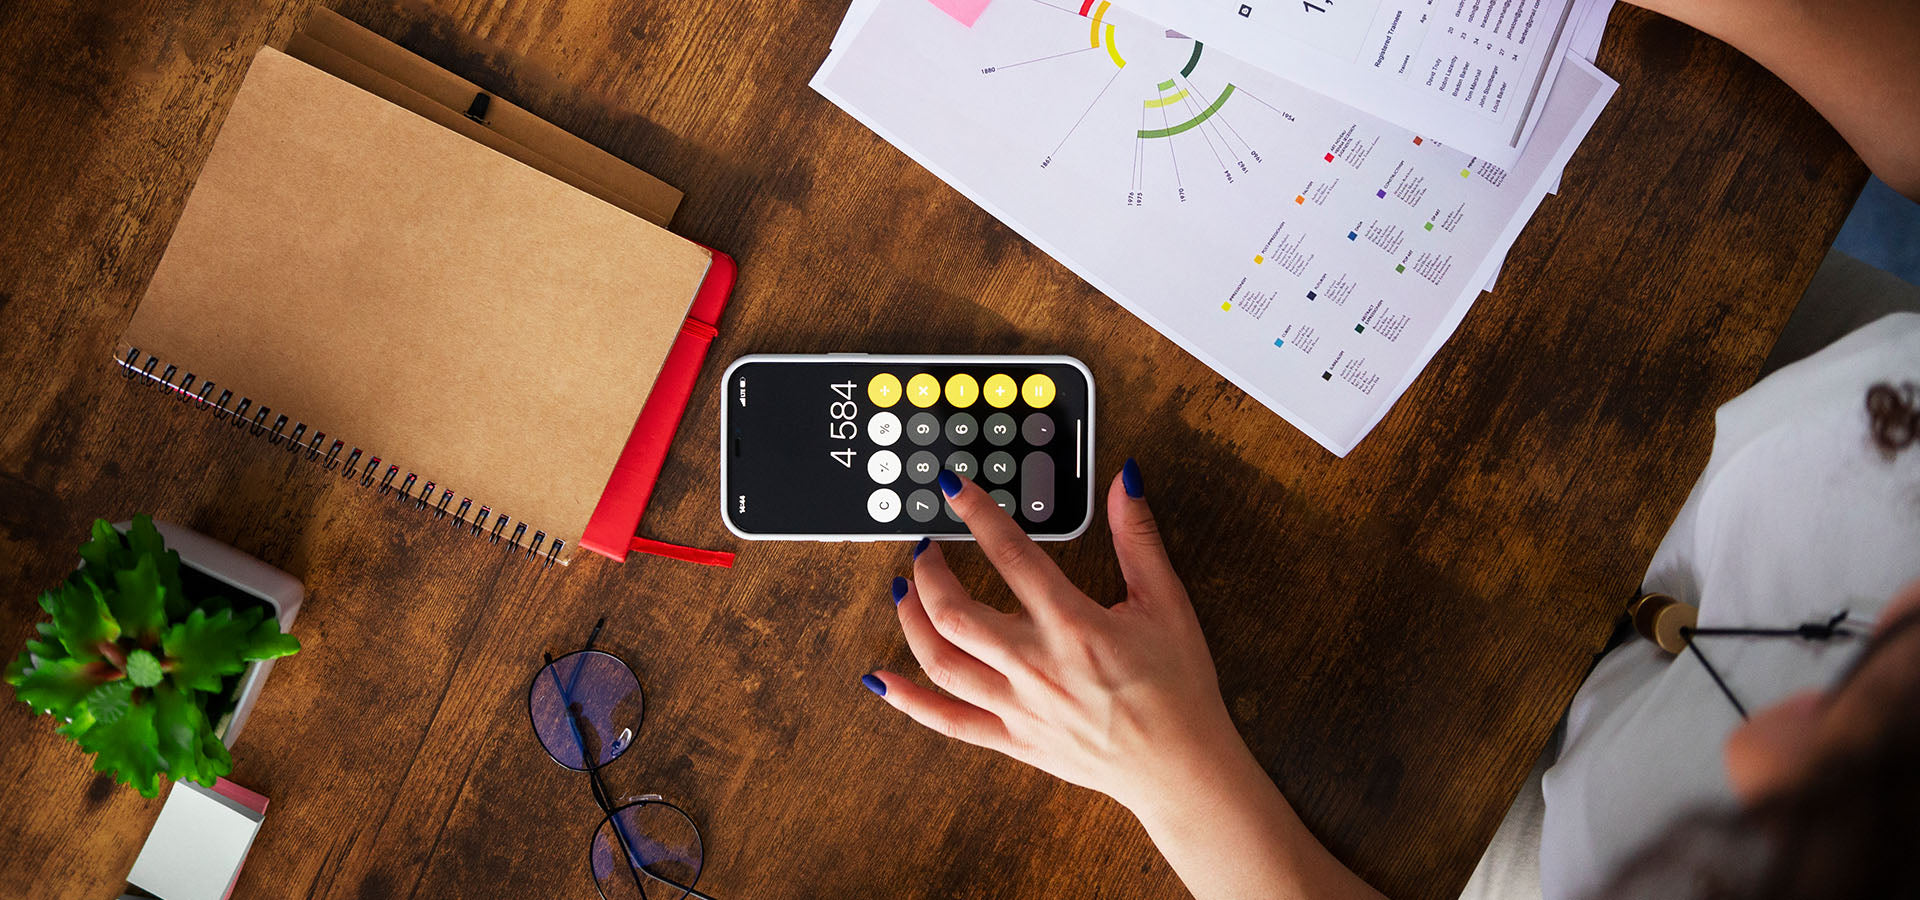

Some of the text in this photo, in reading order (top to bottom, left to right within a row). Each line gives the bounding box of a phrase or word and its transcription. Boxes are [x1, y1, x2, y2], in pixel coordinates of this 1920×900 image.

[1374, 10, 1402, 68] Registered Trainees
[1426, 71, 1436, 86] David
[1447, 26, 1454, 34] 20
[1439, 76, 1449, 92] Robin
[1460, 32, 1467, 40] 23
[1398, 55, 1410, 74] Trainees
[1452, 79, 1463, 97] Bradon
[1459, 61, 1470, 79] Barber
[1478, 95, 1487, 108] John
[1499, 48, 1505, 56] 27
[1464, 90, 1474, 102] Tom
[1470, 69, 1482, 90] Marshall
[1491, 99, 1501, 113] Louis
[1497, 82, 1507, 99] Barber
[1282, 112, 1295, 122] 1954
[1040, 156, 1052, 169] 1867
[1250, 150, 1262, 163] 1960
[1237, 159, 1249, 174] 1962
[1224, 170, 1234, 184] 1964
[1178, 188, 1186, 202] 1970
[830, 380, 858, 468] 4 584
[880, 423, 890, 435] %
[917, 424, 930, 434] 9
[955, 424, 968, 434] 6
[994, 425, 1007, 434] 3
[916, 463, 929, 472] 8
[955, 463, 968, 472] 5
[993, 463, 1006, 472] 2
[879, 501, 890, 510] C
[916, 501, 929, 510] 7
[1031, 501, 1044, 511] 0
